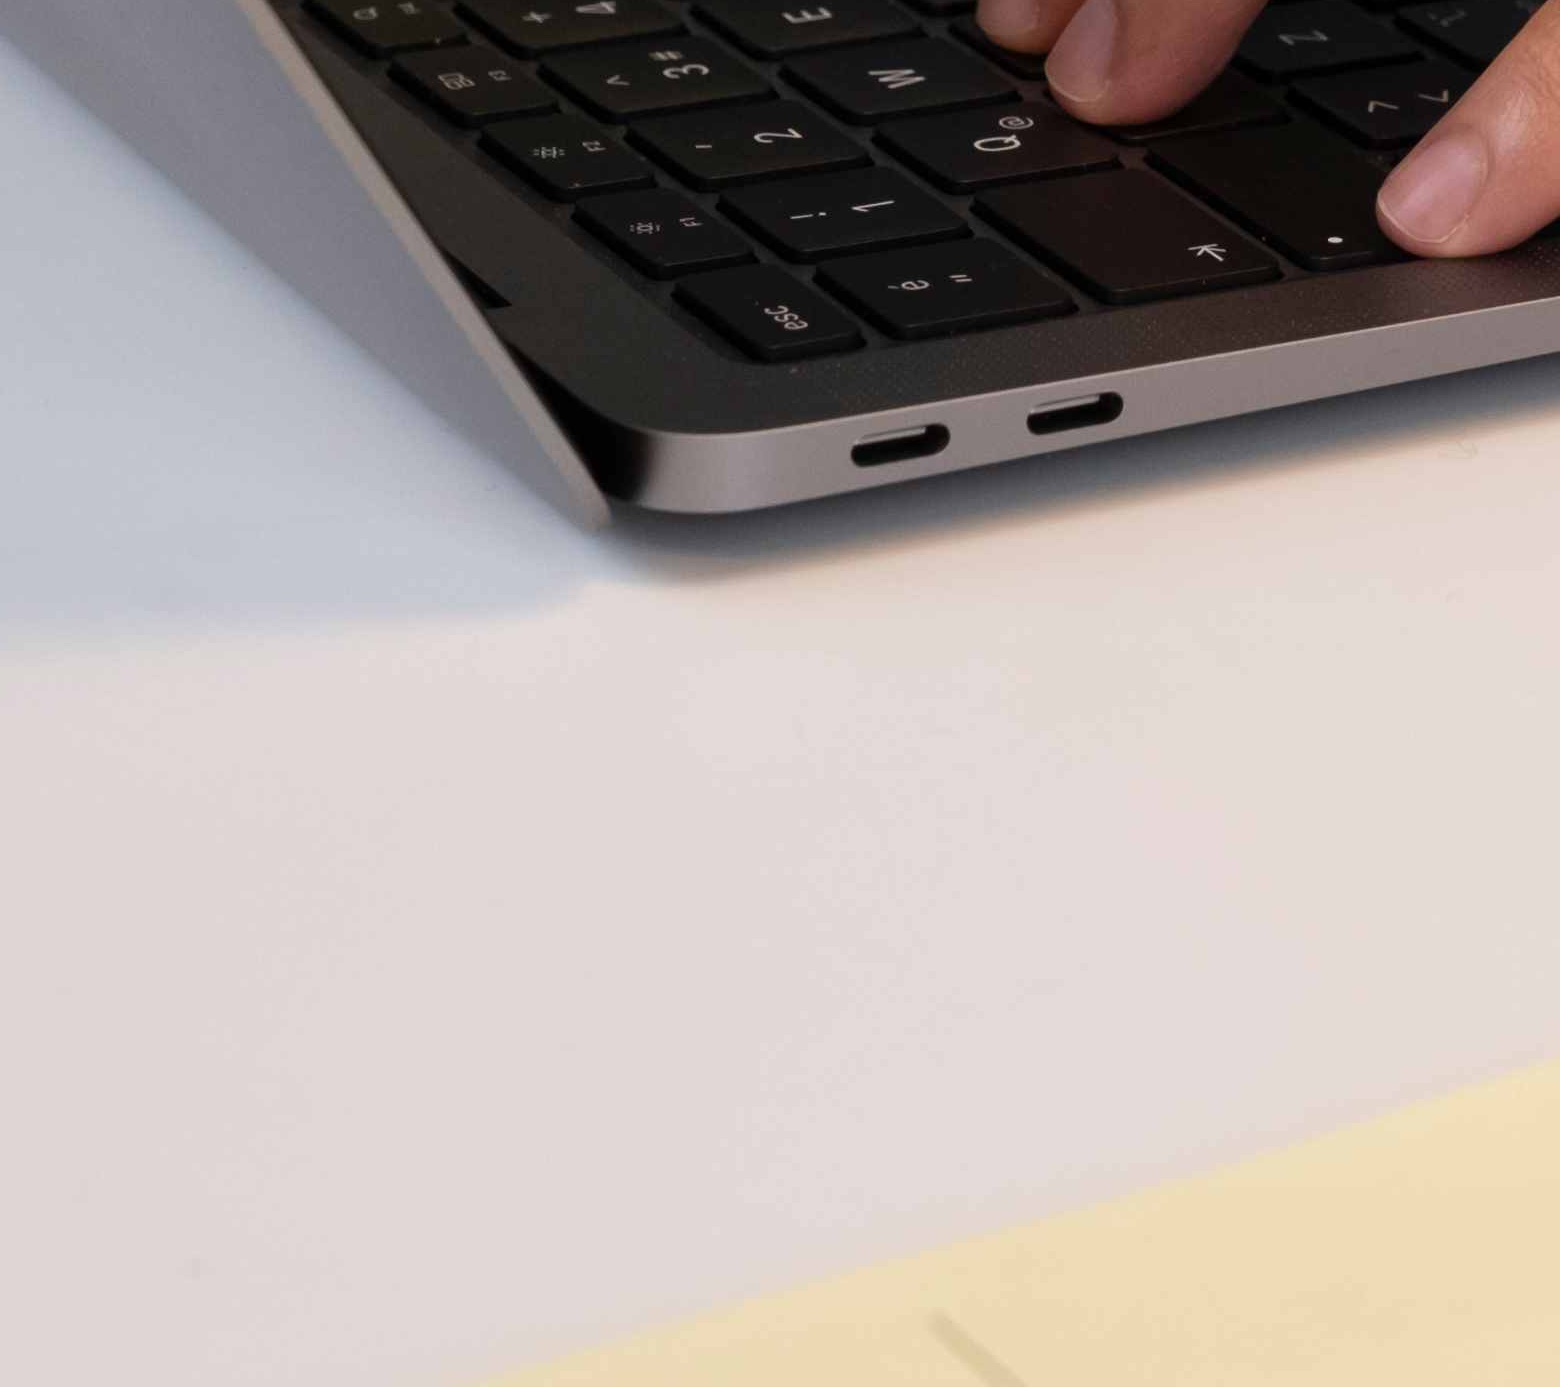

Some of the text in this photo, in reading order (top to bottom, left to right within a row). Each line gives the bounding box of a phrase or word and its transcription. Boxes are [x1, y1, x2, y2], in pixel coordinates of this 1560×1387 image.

[575, 0, 617, 17] 4
[781, 5, 832, 25] E
[1279, 29, 1328, 47] Z
[662, 63, 710, 81] 3
[868, 67, 926, 90] W
[753, 127, 803, 145] 2
[973, 134, 1021, 153] Q
[851, 200, 896, 213] 1
[764, 305, 808, 331] esc
